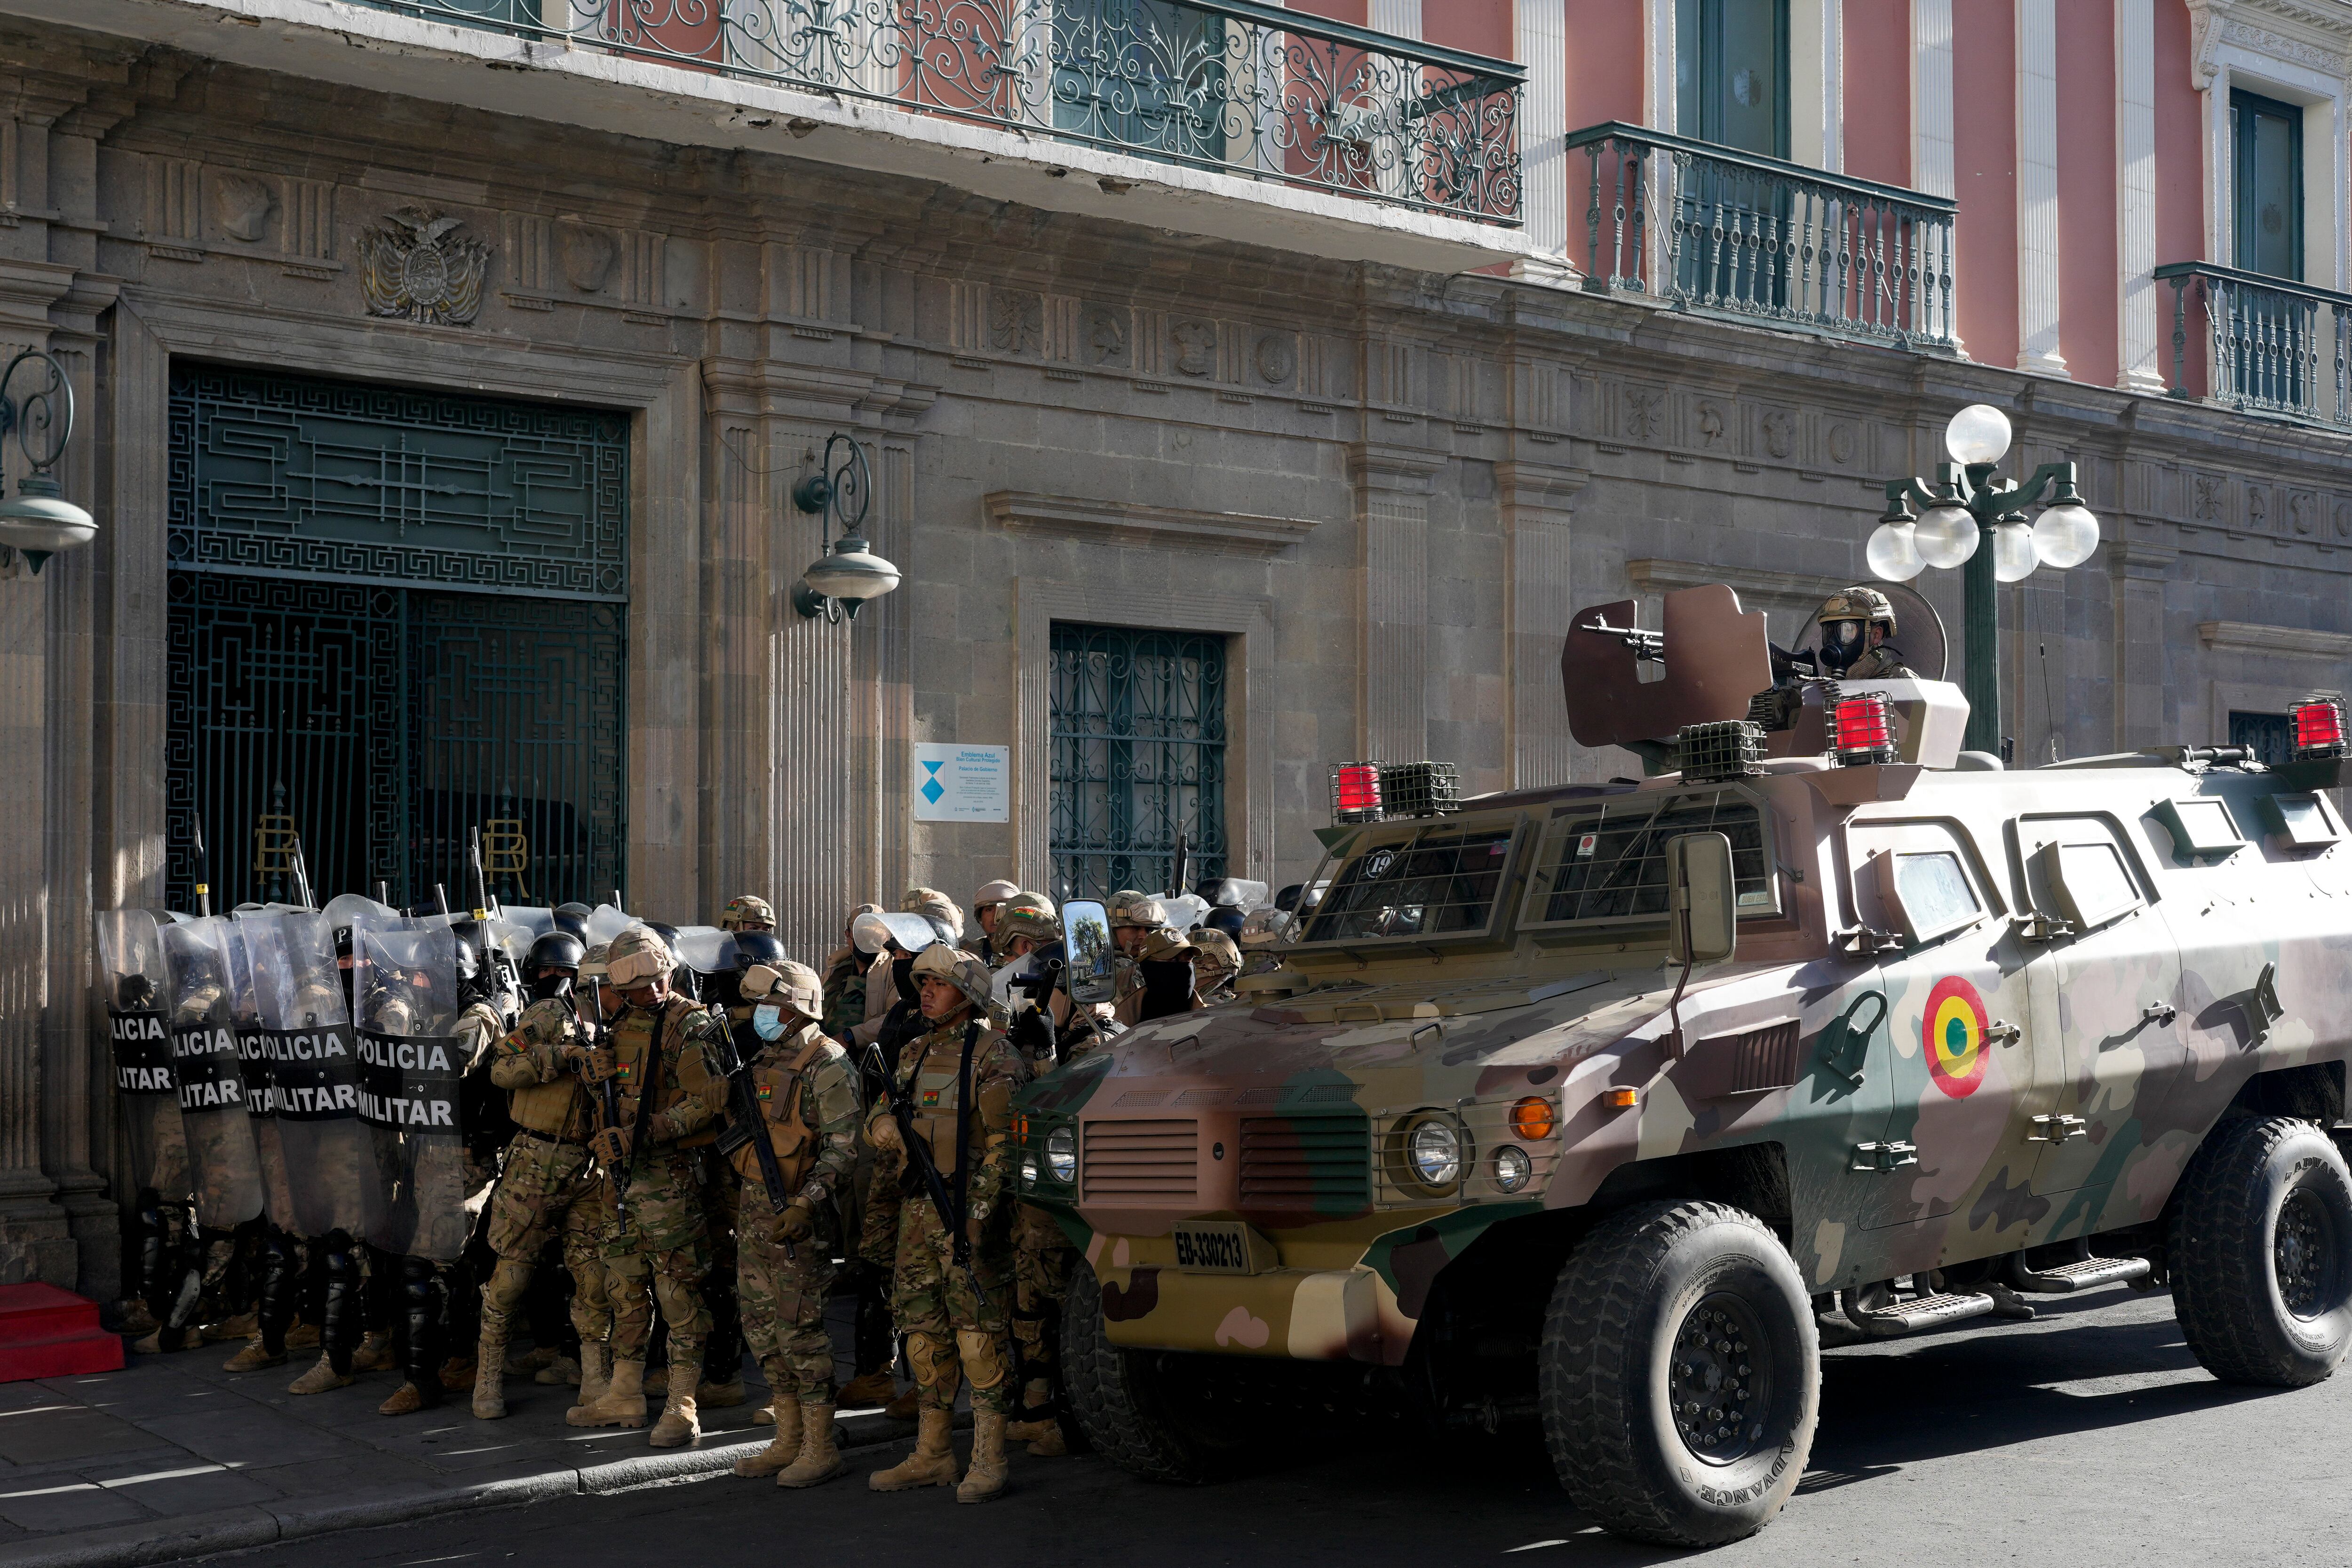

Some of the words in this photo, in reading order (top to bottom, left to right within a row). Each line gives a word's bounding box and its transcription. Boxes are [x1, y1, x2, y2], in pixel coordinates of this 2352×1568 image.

[1371, 856, 1391, 873] 19
[109, 1017, 166, 1040] OLICIA
[170, 1028, 234, 1058] OLICIA
[235, 1035, 266, 1060] LICI
[357, 1035, 452, 1071] POLICIA
[116, 1067, 172, 1090] LITAR
[178, 1079, 241, 1109] LITAR
[358, 1089, 454, 1125] MILITAR
[1175, 1232, 1243, 1268] EB-330213
[1700, 1431, 1796, 1506] ADVANCE
